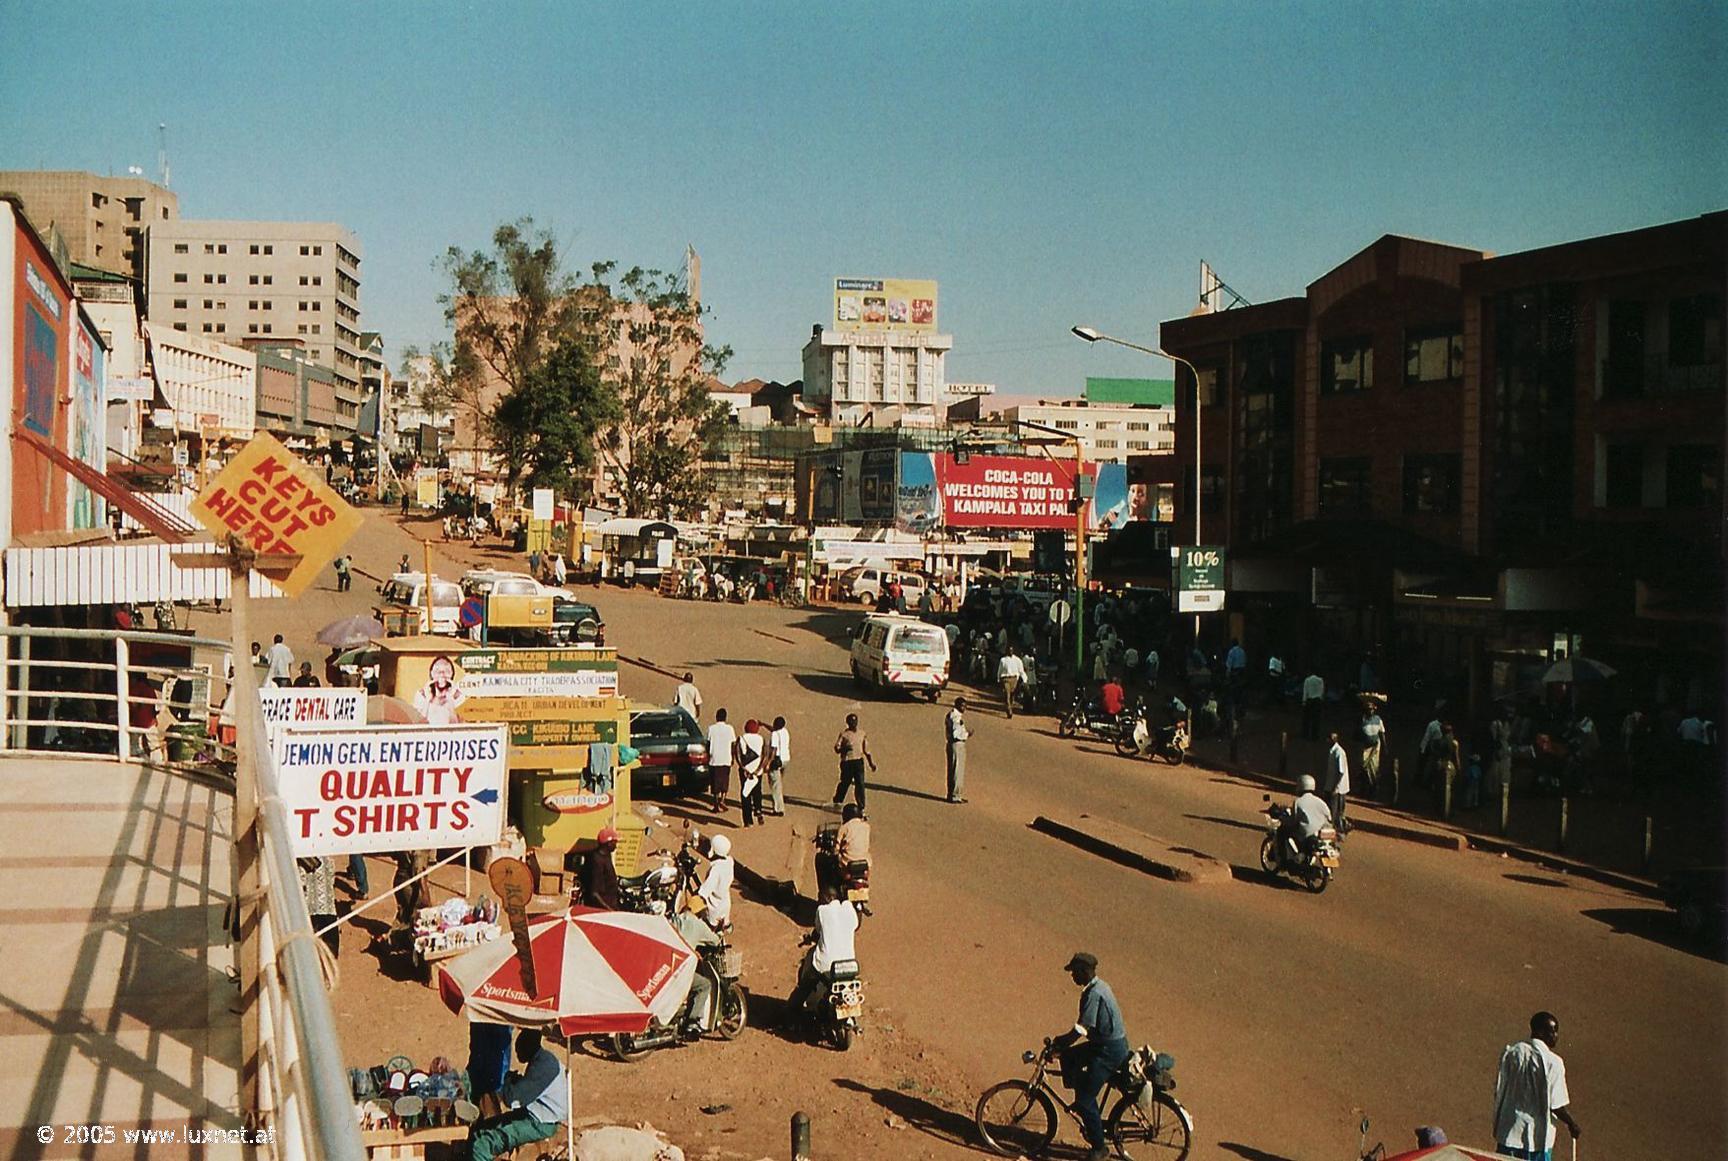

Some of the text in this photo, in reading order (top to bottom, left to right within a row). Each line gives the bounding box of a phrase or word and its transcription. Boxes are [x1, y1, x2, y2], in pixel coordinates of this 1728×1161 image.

[984, 469, 1054, 485] COCA-COLA
[252, 455, 336, 527] KEYS
[944, 483, 1019, 499] WELCOMES
[1021, 486, 1046, 500] YOU
[1049, 487, 1064, 501] TO
[238, 479, 309, 538] CUT
[953, 499, 1017, 515] KAMPALA
[1019, 502, 1046, 516] TAXI
[1186, 551, 1219, 567] 10%
[294, 697, 330, 721] DENTAL
[333, 697, 357, 721] CARE
[281, 743, 334, 766] JEMON
[337, 742, 376, 765] GEN.
[380, 739, 499, 763] ENTERPRISES
[320, 767, 474, 801] QUALITY
[294, 800, 474, 839] T. SHIRTS.
[480, 982, 532, 1002] Sportsma
[637, 963, 671, 1001] Sportsman
